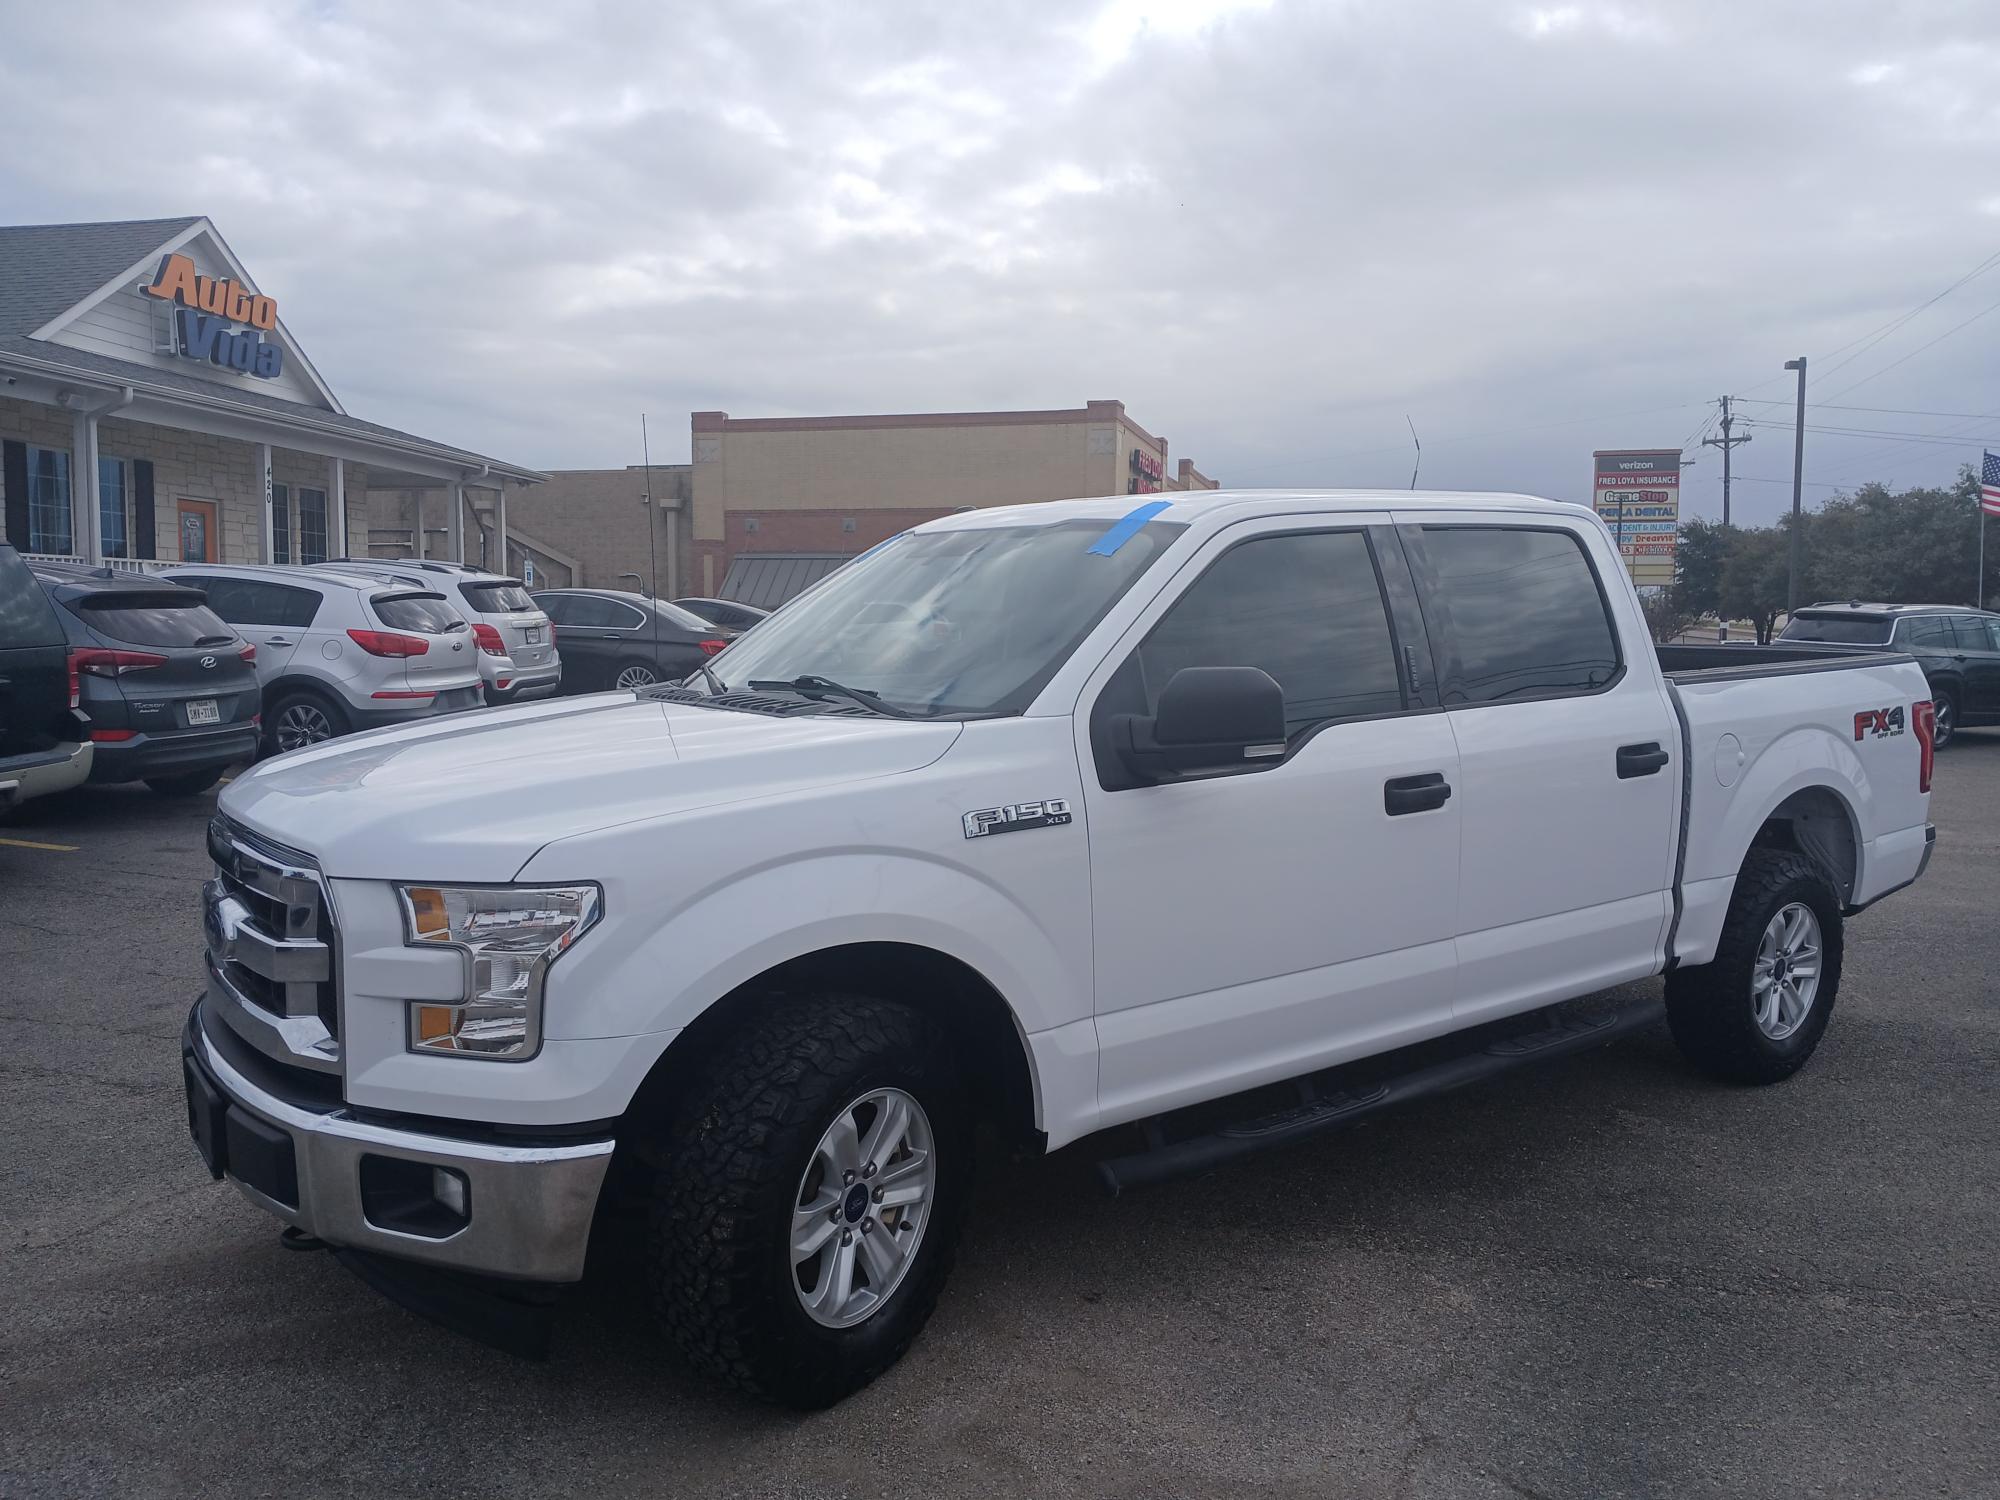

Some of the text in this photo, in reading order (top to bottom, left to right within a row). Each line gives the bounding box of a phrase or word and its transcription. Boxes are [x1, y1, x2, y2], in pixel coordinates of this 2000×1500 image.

[147, 252, 278, 331] Auto
[180, 309, 283, 379] Vida
[1619, 461, 1653, 469] verizon
[1598, 476, 1677, 485] FRED LOYA INSURANCE
[1599, 508, 1632, 517] PERA
[1854, 706, 1904, 741] FX4
[1046, 815, 1068, 824] XLT
